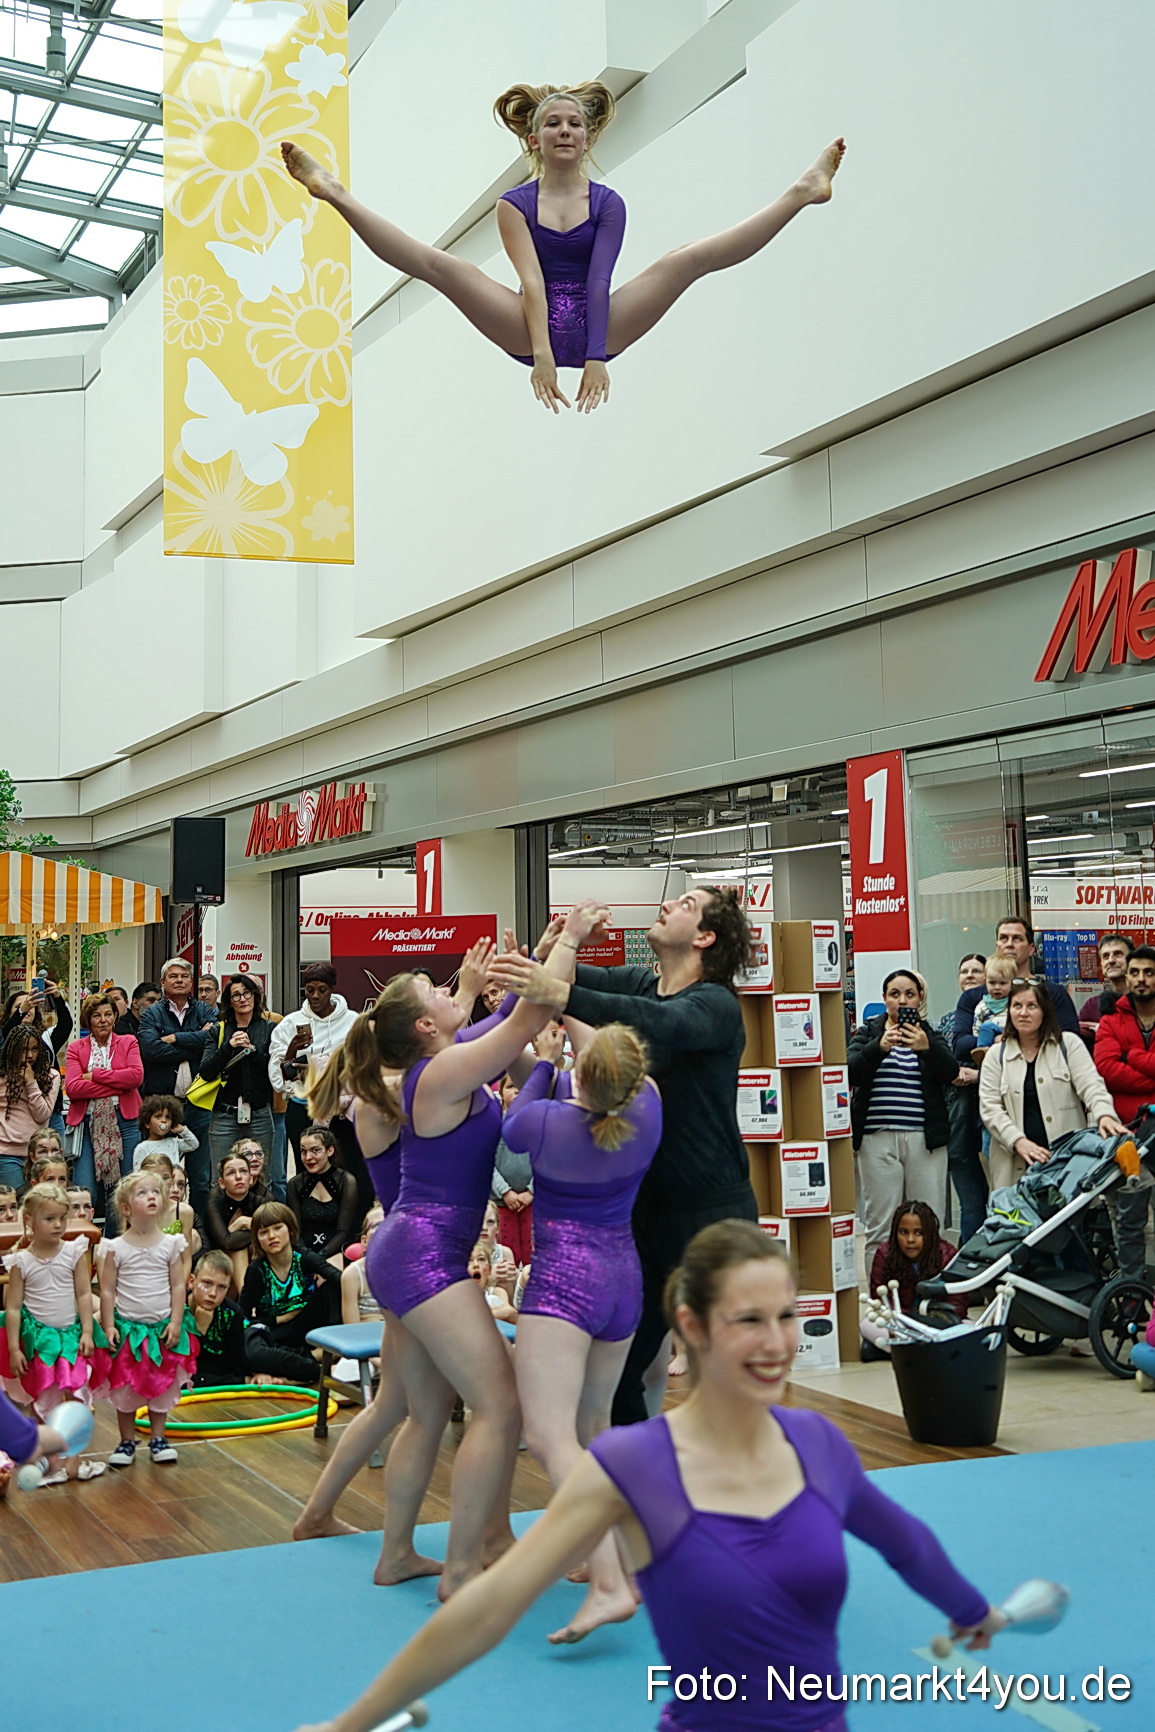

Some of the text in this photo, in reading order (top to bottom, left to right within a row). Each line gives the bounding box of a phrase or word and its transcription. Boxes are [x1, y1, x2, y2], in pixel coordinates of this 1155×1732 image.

[864, 768, 888, 864] 1
[423, 850, 436, 914] 1
[862, 873, 896, 893] Stunde
[1033, 895, 1049, 905] TREK
[1076, 886, 1155, 905] SOFTWAR
[1128, 914, 1154, 926] Filme
[1076, 933, 1088, 942] Top
[1088, 933, 1096, 941] 10
[230, 943, 258, 951] Online-
[392, 943, 437, 952] PRÄSENTIERT
[225, 953, 263, 962] Abholung
